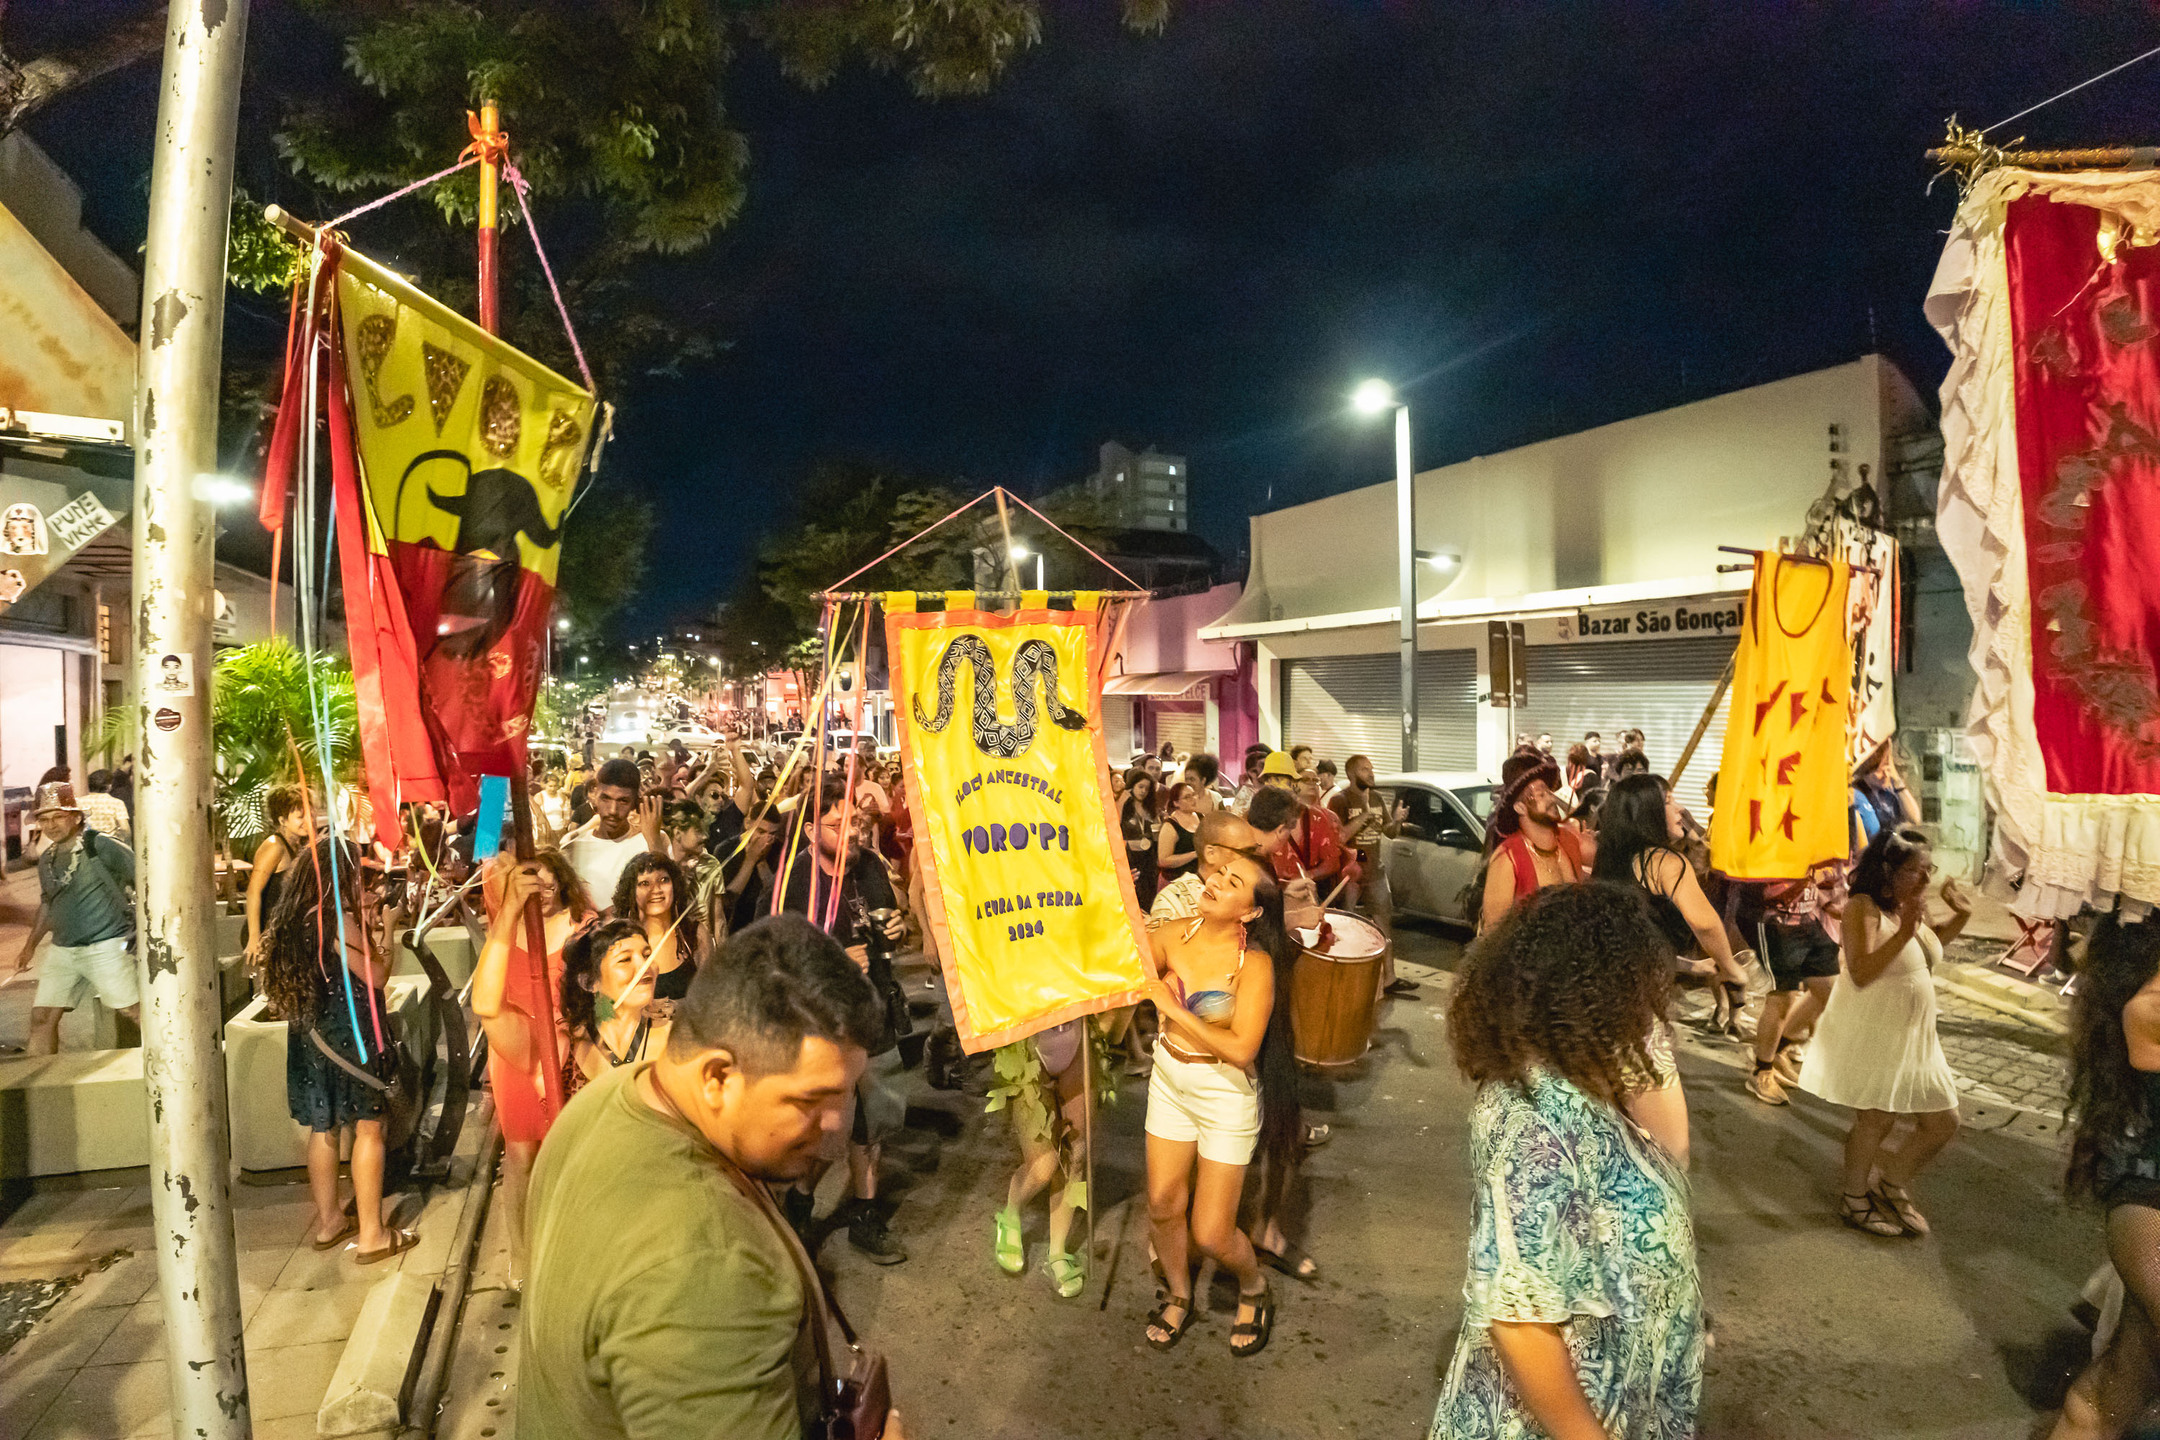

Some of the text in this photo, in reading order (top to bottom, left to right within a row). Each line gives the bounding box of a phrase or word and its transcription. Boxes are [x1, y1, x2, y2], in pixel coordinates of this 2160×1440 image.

[1578, 613, 1630, 636] Bazar
[1636, 611, 1671, 634] São
[986, 769, 1062, 804] ANCESTRAL
[976, 890, 1083, 920] A CURA DA TERRA
[1008, 919, 1044, 942] 2024
